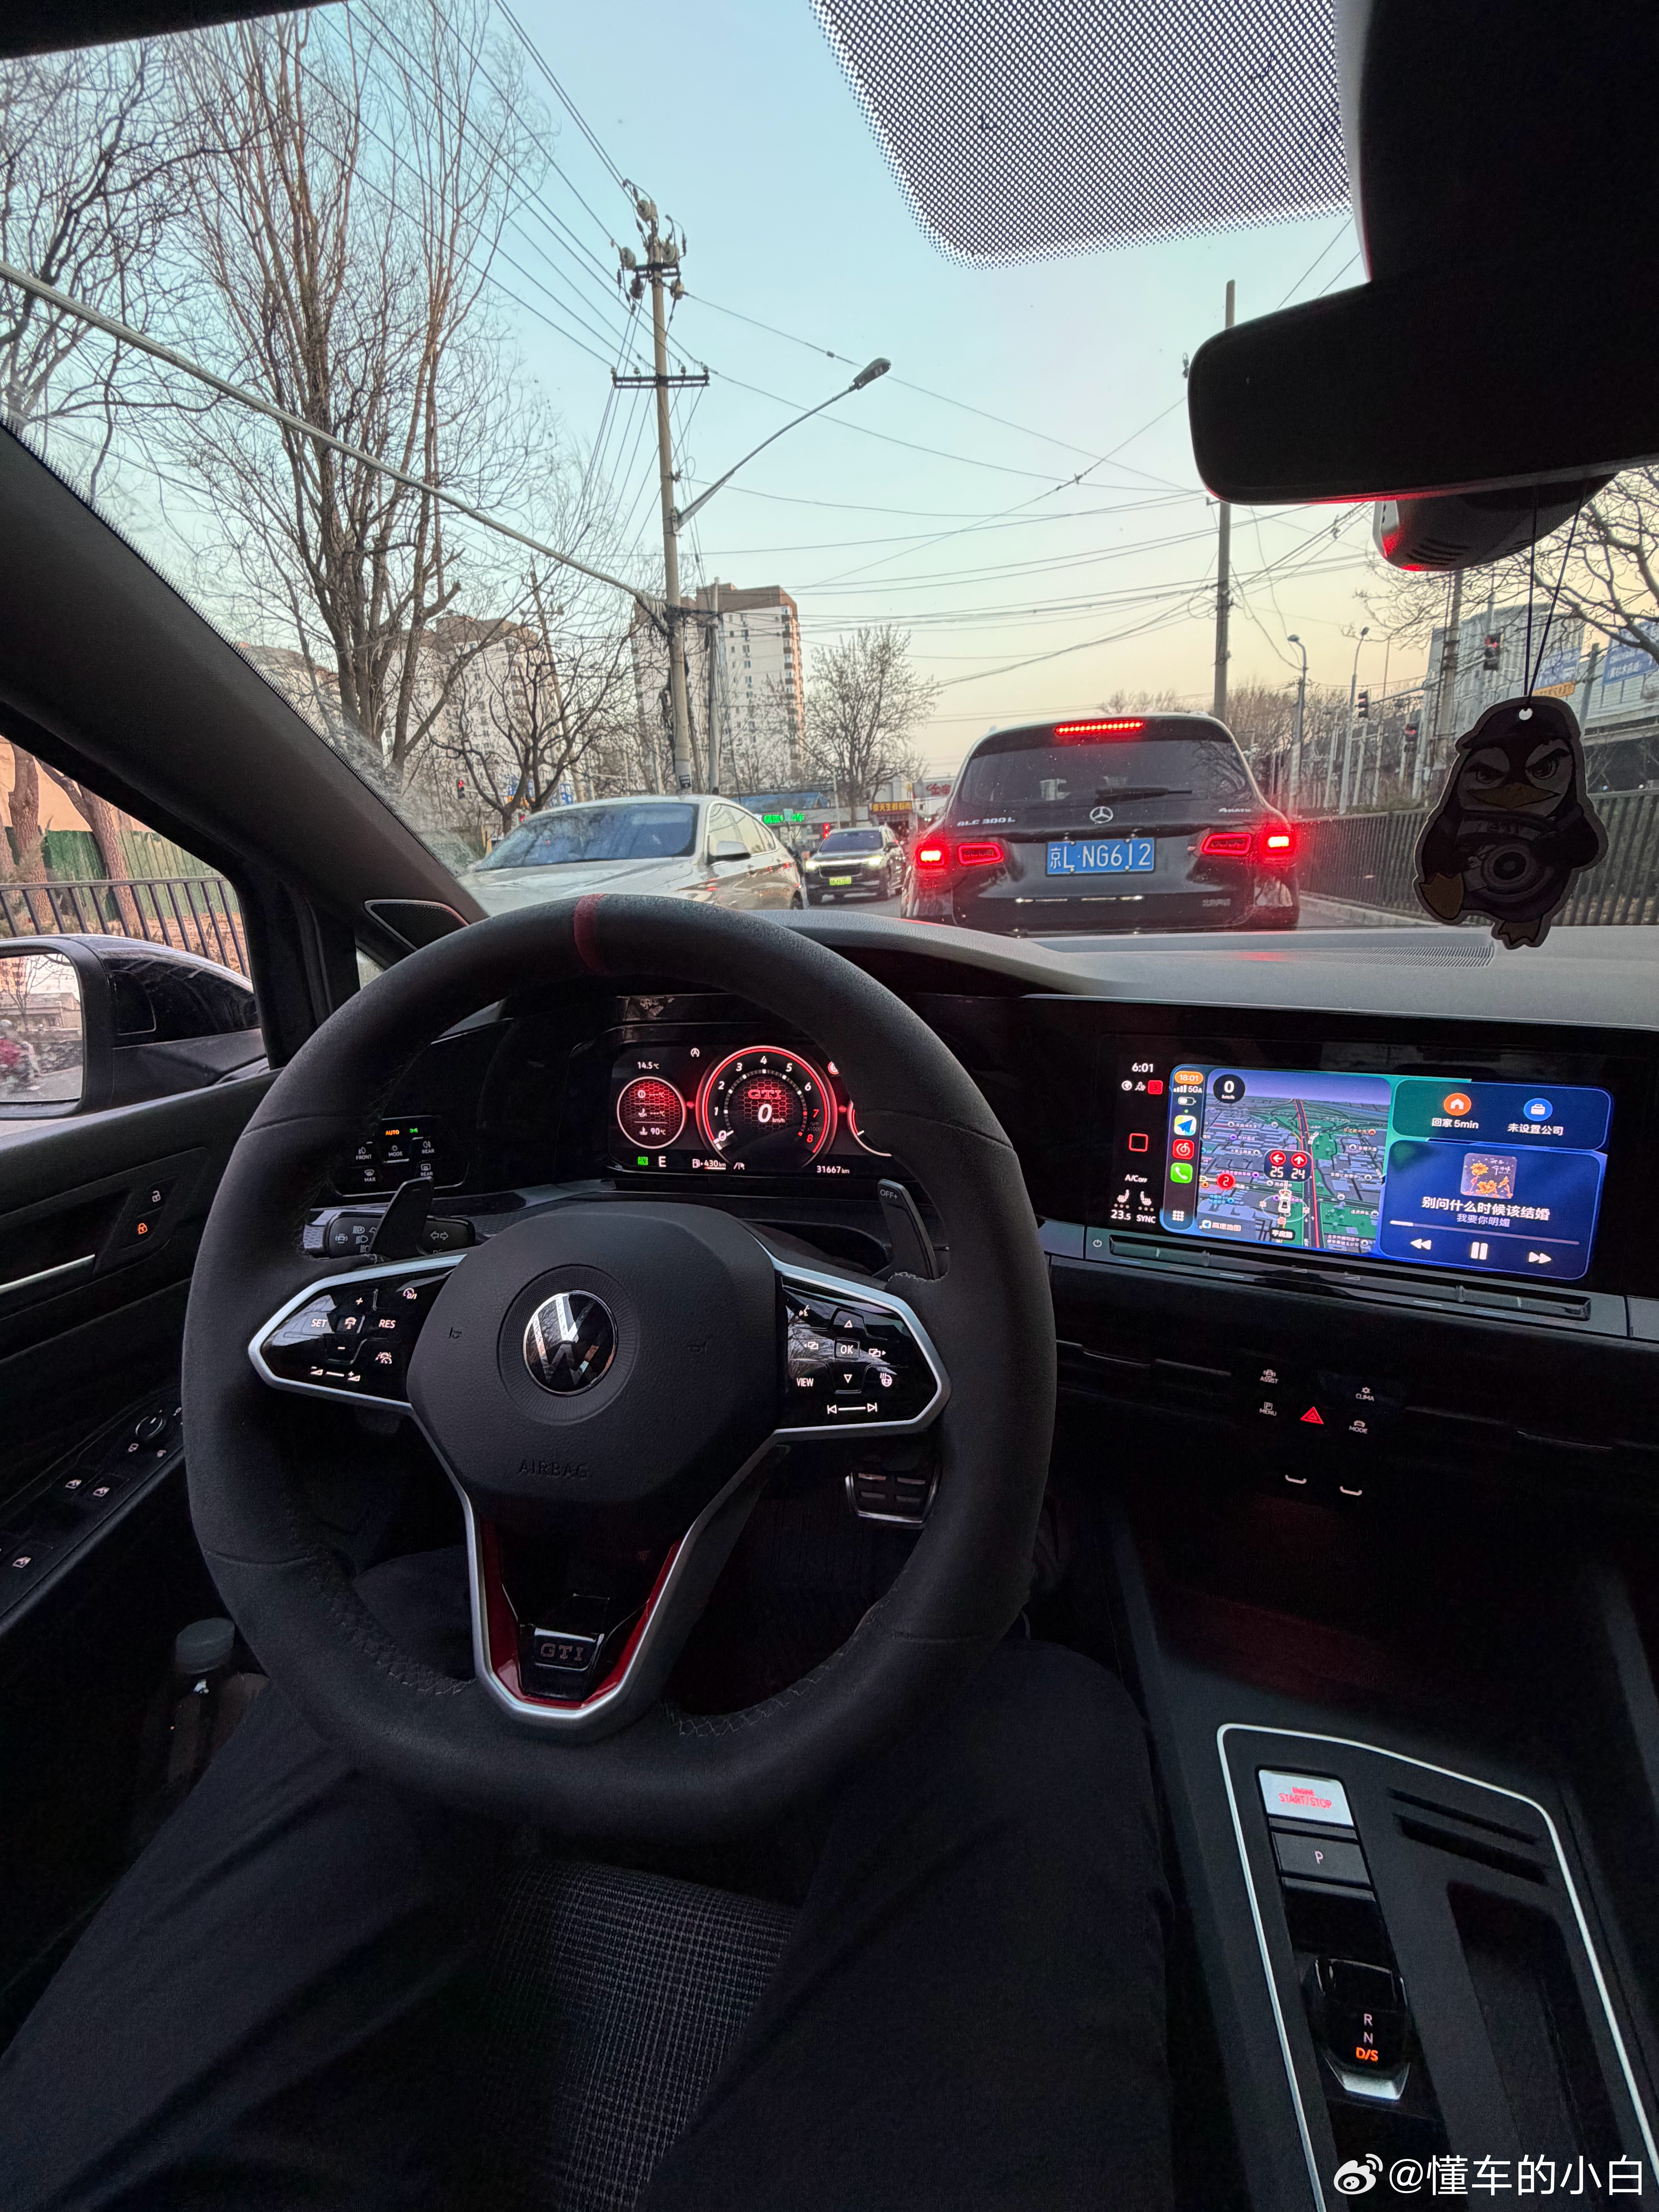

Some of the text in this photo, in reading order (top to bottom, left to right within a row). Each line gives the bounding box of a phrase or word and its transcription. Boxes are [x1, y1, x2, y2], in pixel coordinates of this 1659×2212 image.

[760, 1056, 767, 1064] 4
[736, 1063, 742, 1071] 3
[786, 1063, 793, 1072] 5
[1132, 1062, 1154, 1073] 6:01
[718, 1081, 725, 1090] 2
[805, 1082, 812, 1091] 6
[1224, 1080, 1235, 1093] 0
[748, 1089, 781, 1100] GTI
[714, 1107, 719, 1116] 1
[758, 1104, 772, 1123] 0
[813, 1109, 819, 1118] 7
[1432, 1118, 1479, 1129] 回家 5min
[1508, 1123, 1564, 1136] 未设置公司
[718, 1130, 727, 1141] 0
[807, 1134, 813, 1143] 8
[658, 1156, 666, 1167] E
[817, 1165, 841, 1173] 31667
[1270, 1166, 1284, 1178] 25
[1291, 1168, 1305, 1179] 24
[1111, 1209, 1131, 1220] 23.5
[1422, 1197, 1551, 1221] 别问什么时候该结婚
[1136, 1214, 1156, 1224] SYNC
[311, 1319, 327, 1328] SET
[379, 1319, 396, 1329] RES
[840, 1345, 854, 1355] OK
[797, 1377, 814, 1387] VIEW
[1259, 1376, 1279, 1384] ASSIST
[1356, 1393, 1374, 1401] CLIMA
[1259, 1408, 1277, 1416] MENU
[1349, 1425, 1368, 1434] MODE
[519, 1459, 587, 1480] AIRBAG
[541, 1643, 584, 1661] GTI
[1278, 1793, 1332, 1809] START/STOP
[1315, 1850, 1323, 1864] P
[1364, 2014, 1372, 2026] R
[1364, 2032, 1373, 2044] N
[1356, 2047, 1378, 2061] D/S
